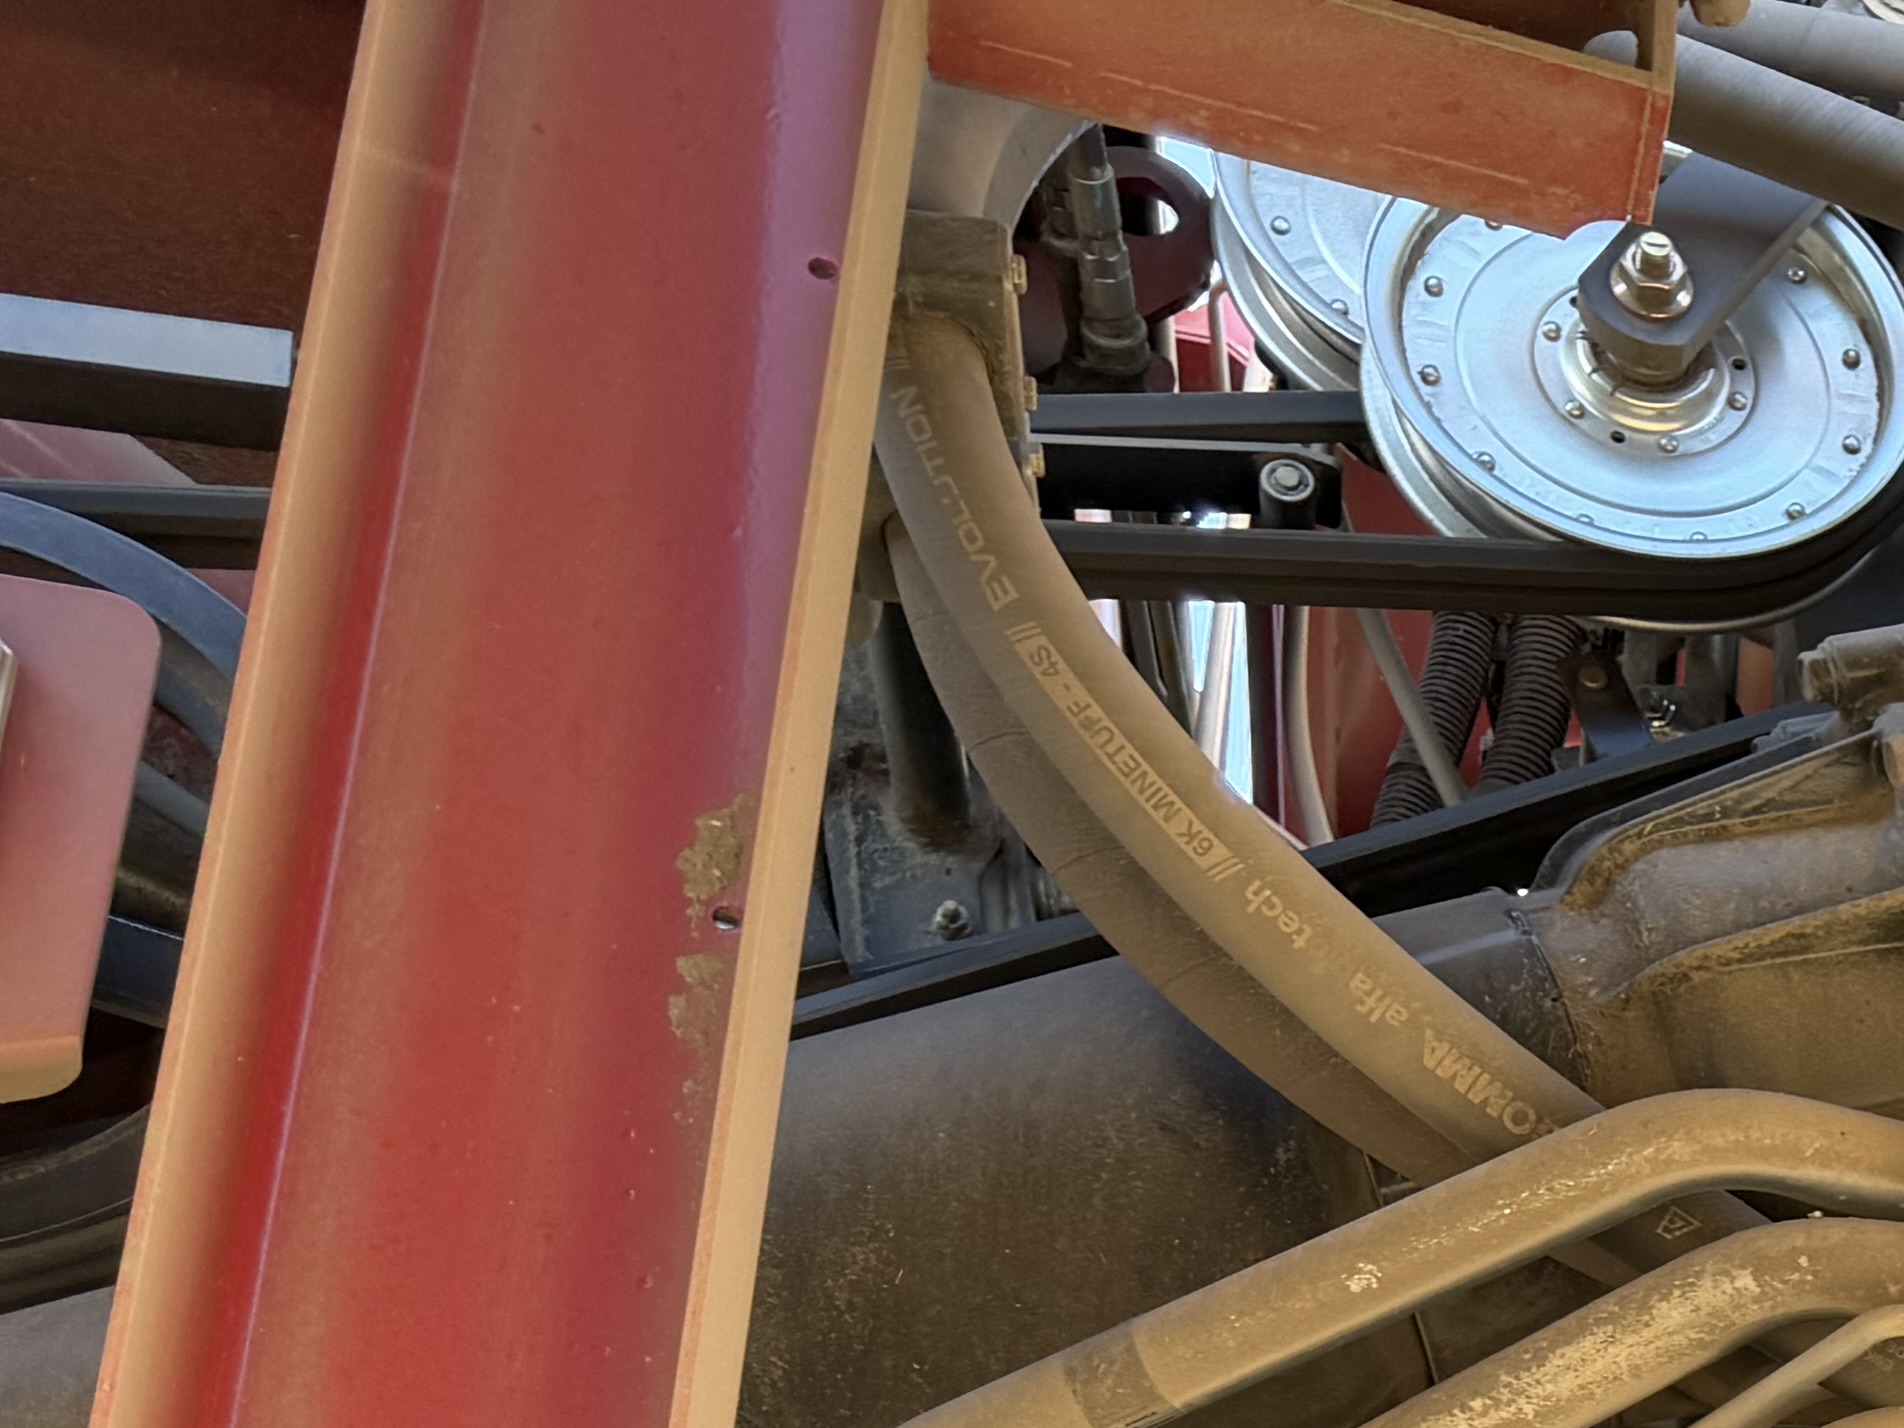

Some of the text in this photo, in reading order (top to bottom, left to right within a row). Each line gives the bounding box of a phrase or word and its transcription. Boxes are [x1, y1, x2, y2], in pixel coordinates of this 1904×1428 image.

[1027, 643, 1063, 681] 4S
[1174, 817, 1216, 861] 6K
[1244, 880, 1317, 951] tech
